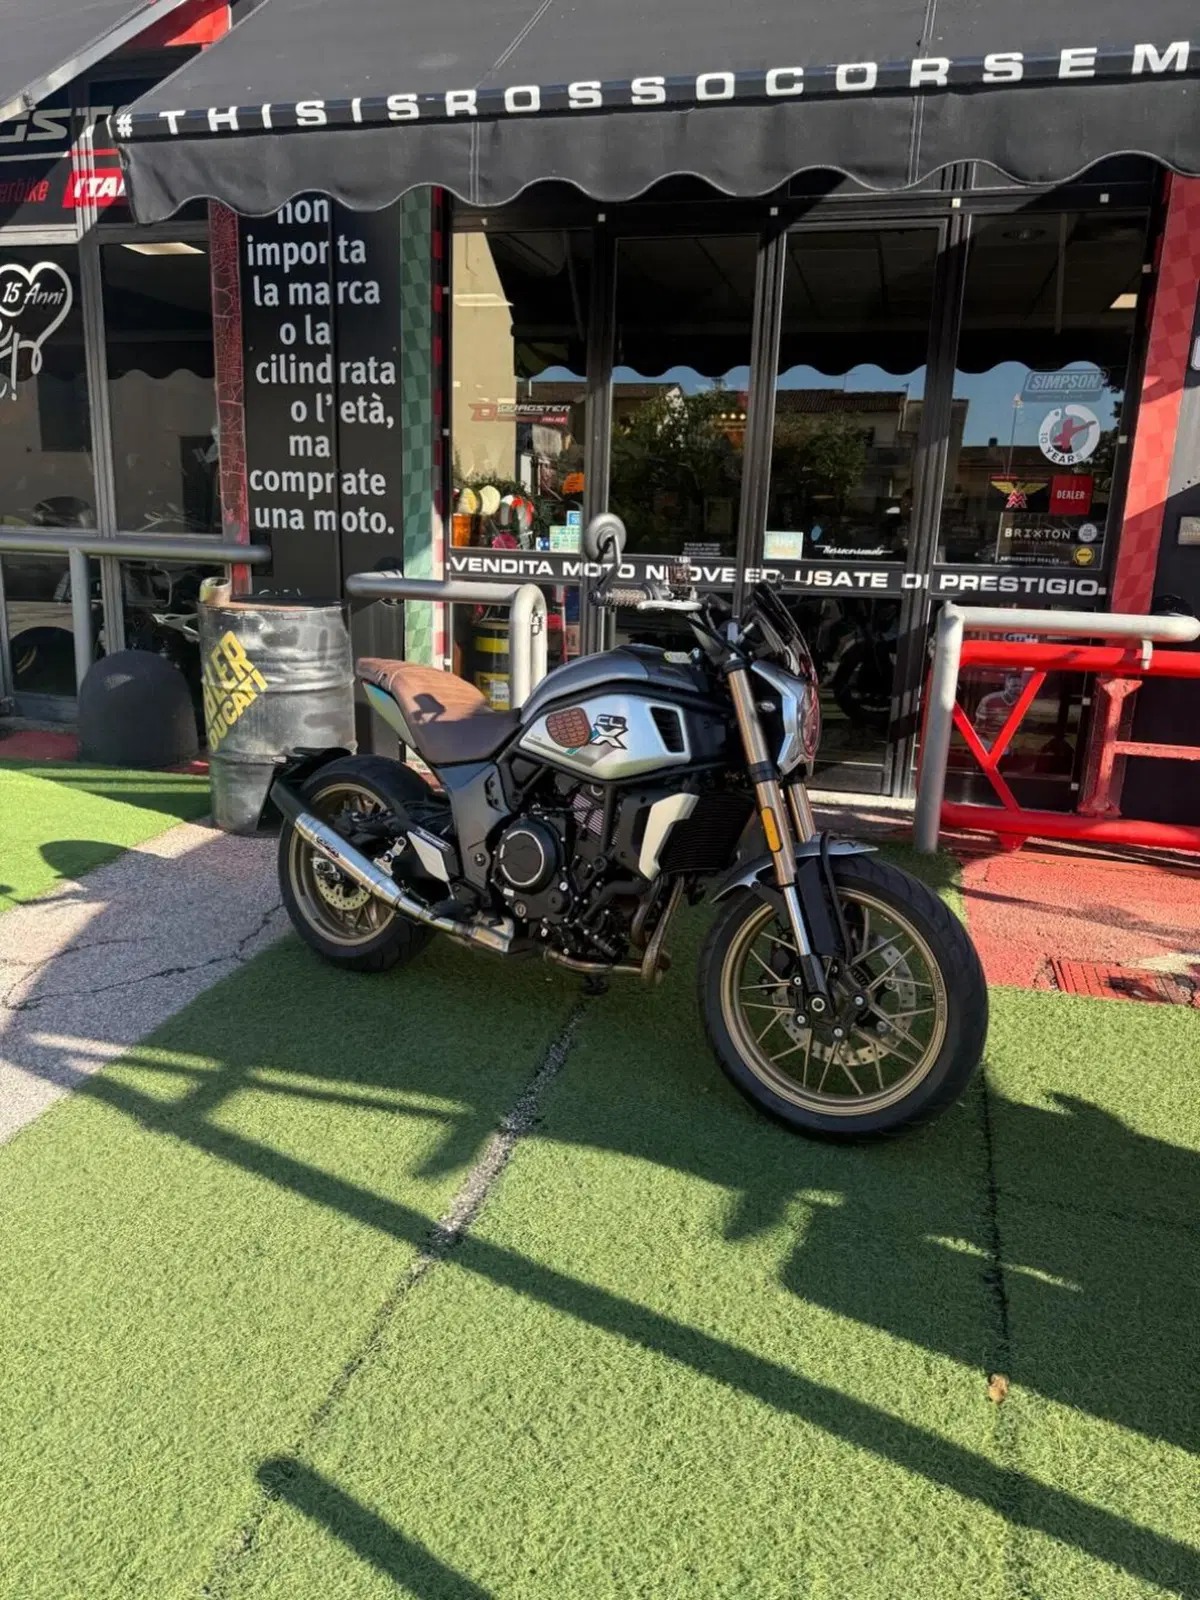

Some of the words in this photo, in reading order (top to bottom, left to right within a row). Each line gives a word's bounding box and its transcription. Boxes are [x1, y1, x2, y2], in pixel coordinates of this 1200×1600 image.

[277, 199, 329, 224] non
[246, 234, 367, 274] importa
[3, 281, 23, 304] 15
[23, 282, 66, 305] Anni
[253, 275, 279, 307] la
[288, 280, 381, 306] marca
[279, 322, 296, 345] o
[304, 313, 332, 346] la
[255, 353, 396, 385] cilindrata
[1031, 374, 1099, 390] SIMPSON
[290, 400, 307, 423] o
[289, 434, 331, 458] ma
[250, 468, 386, 501] comprate
[1056, 489, 1086, 500] DEALER
[255, 507, 305, 531] una
[314, 506, 395, 535] moto.
[1004, 527, 1071, 540] BRIXTON
[562, 561, 636, 579] MOTO
[645, 564, 737, 583] NOVE
[744, 568, 784, 583] ED
[795, 570, 889, 588] USATE
[901, 573, 930, 589] DI
[939, 573, 1107, 596] PRESTIGIO.
[208, 668, 268, 753] DUCATI
